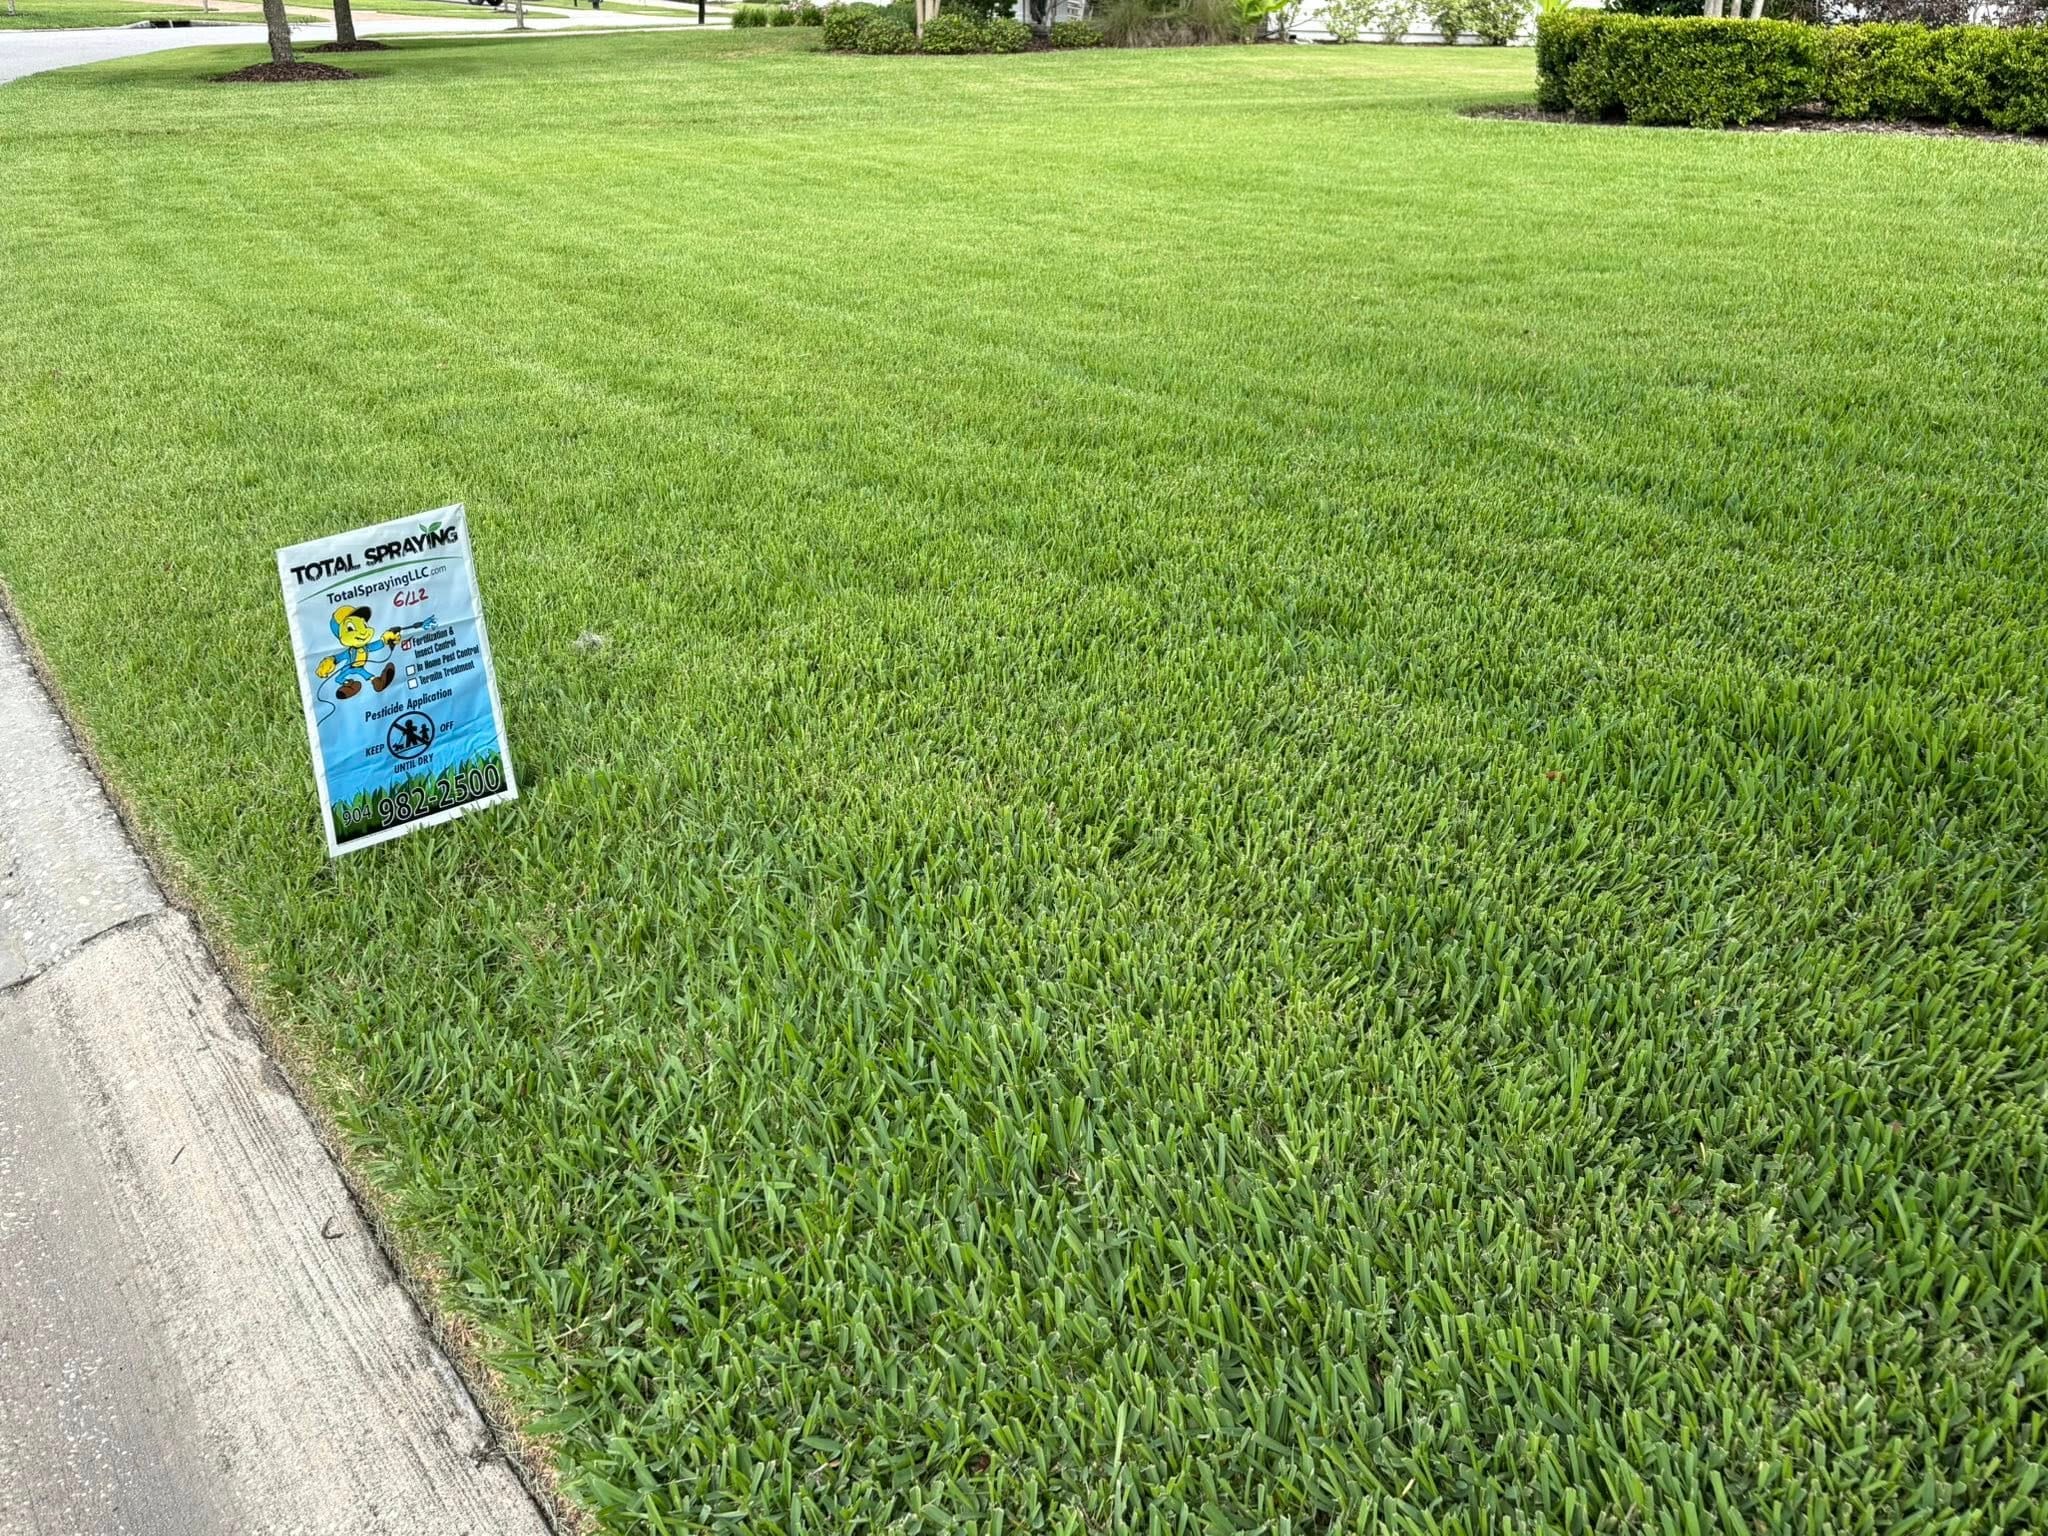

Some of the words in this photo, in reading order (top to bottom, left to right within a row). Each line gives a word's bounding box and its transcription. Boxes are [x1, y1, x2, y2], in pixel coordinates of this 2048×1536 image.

[290, 553, 361, 585] TOTAL
[364, 525, 458, 567] SPRAYING
[326, 564, 447, 605] TotalSprayingLLC.com
[393, 587, 429, 607] 6/12
[412, 629, 448, 647] Fertilization
[448, 626, 455, 636] &
[414, 645, 434, 659] Insect
[434, 638, 457, 653] Control
[416, 663, 424, 672] In
[423, 658, 442, 670] Home
[442, 652, 456, 664] Pest
[456, 645, 480, 659] Control
[418, 670, 443, 685] Termite
[443, 660, 475, 677] Treatment
[365, 702, 404, 722] Pesticide
[406, 688, 453, 710] Application
[365, 744, 385, 757] KEEP
[440, 721, 454, 733] OFF
[394, 761, 416, 774] UNTIL
[418, 753, 434, 767] DRY
[342, 806, 372, 827] 904
[378, 764, 501, 827] 982-2500
